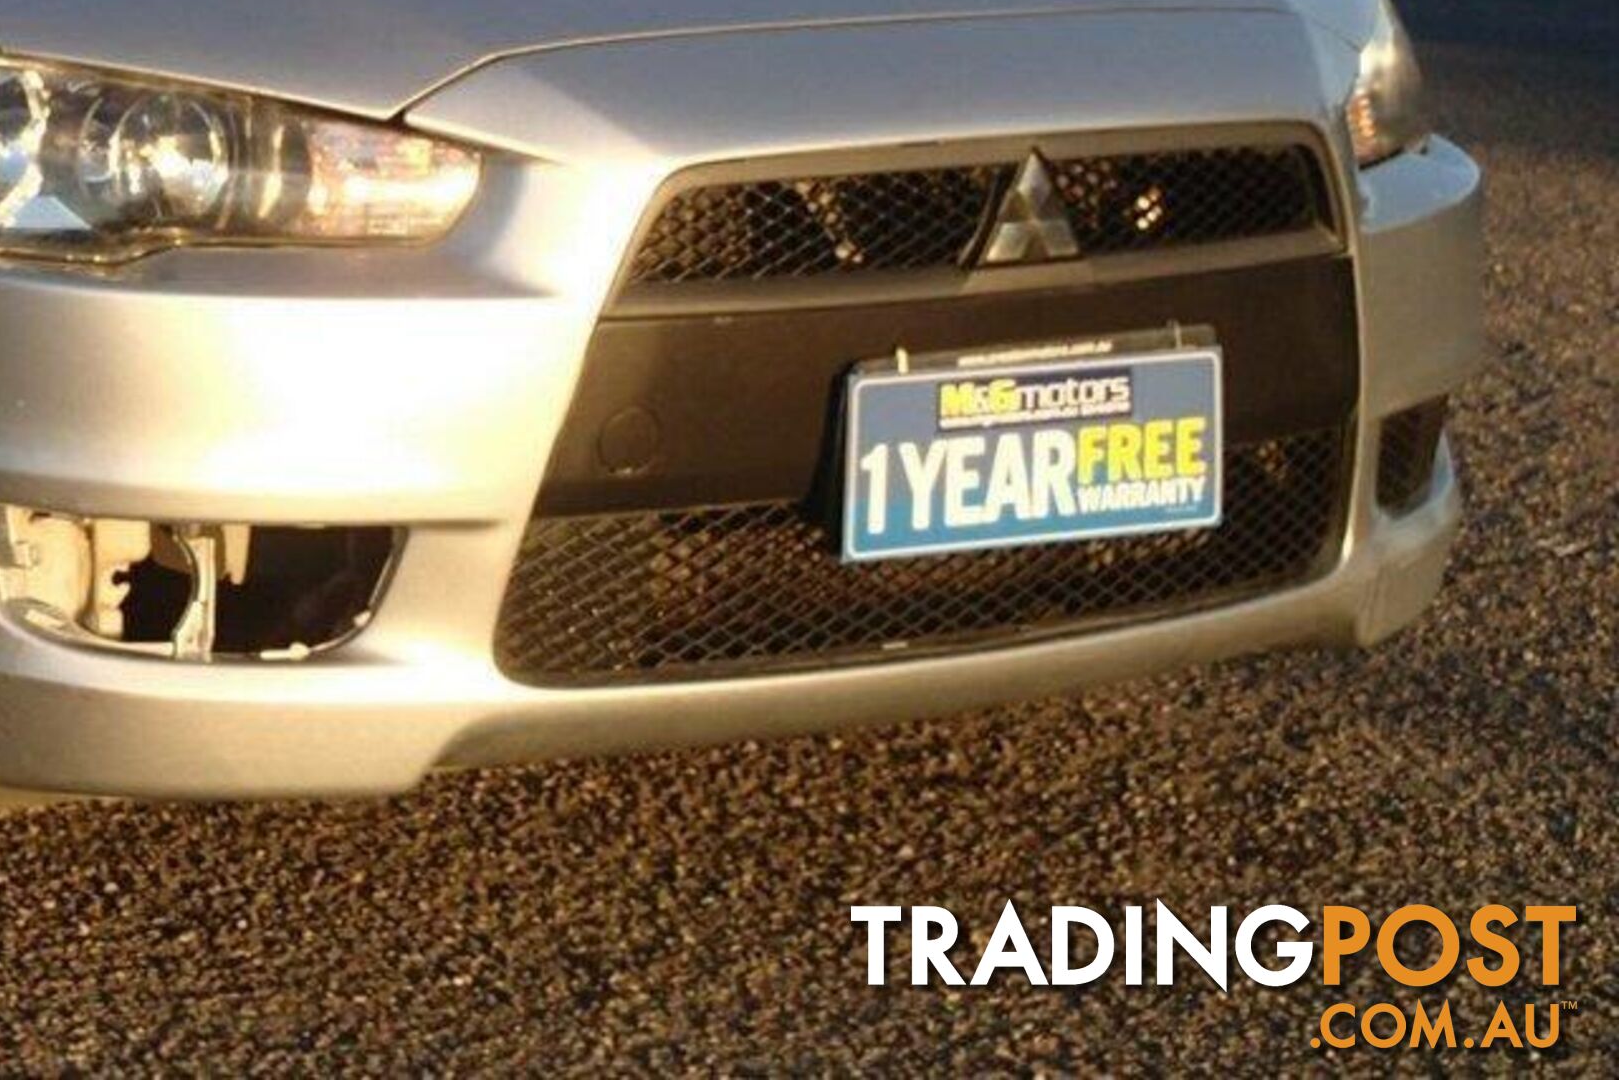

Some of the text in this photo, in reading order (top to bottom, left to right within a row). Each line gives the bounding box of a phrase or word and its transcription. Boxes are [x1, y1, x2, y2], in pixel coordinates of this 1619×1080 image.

[859, 416, 1207, 534] 1 YEAR FREE
[1076, 475, 1205, 514] WARRANTY
